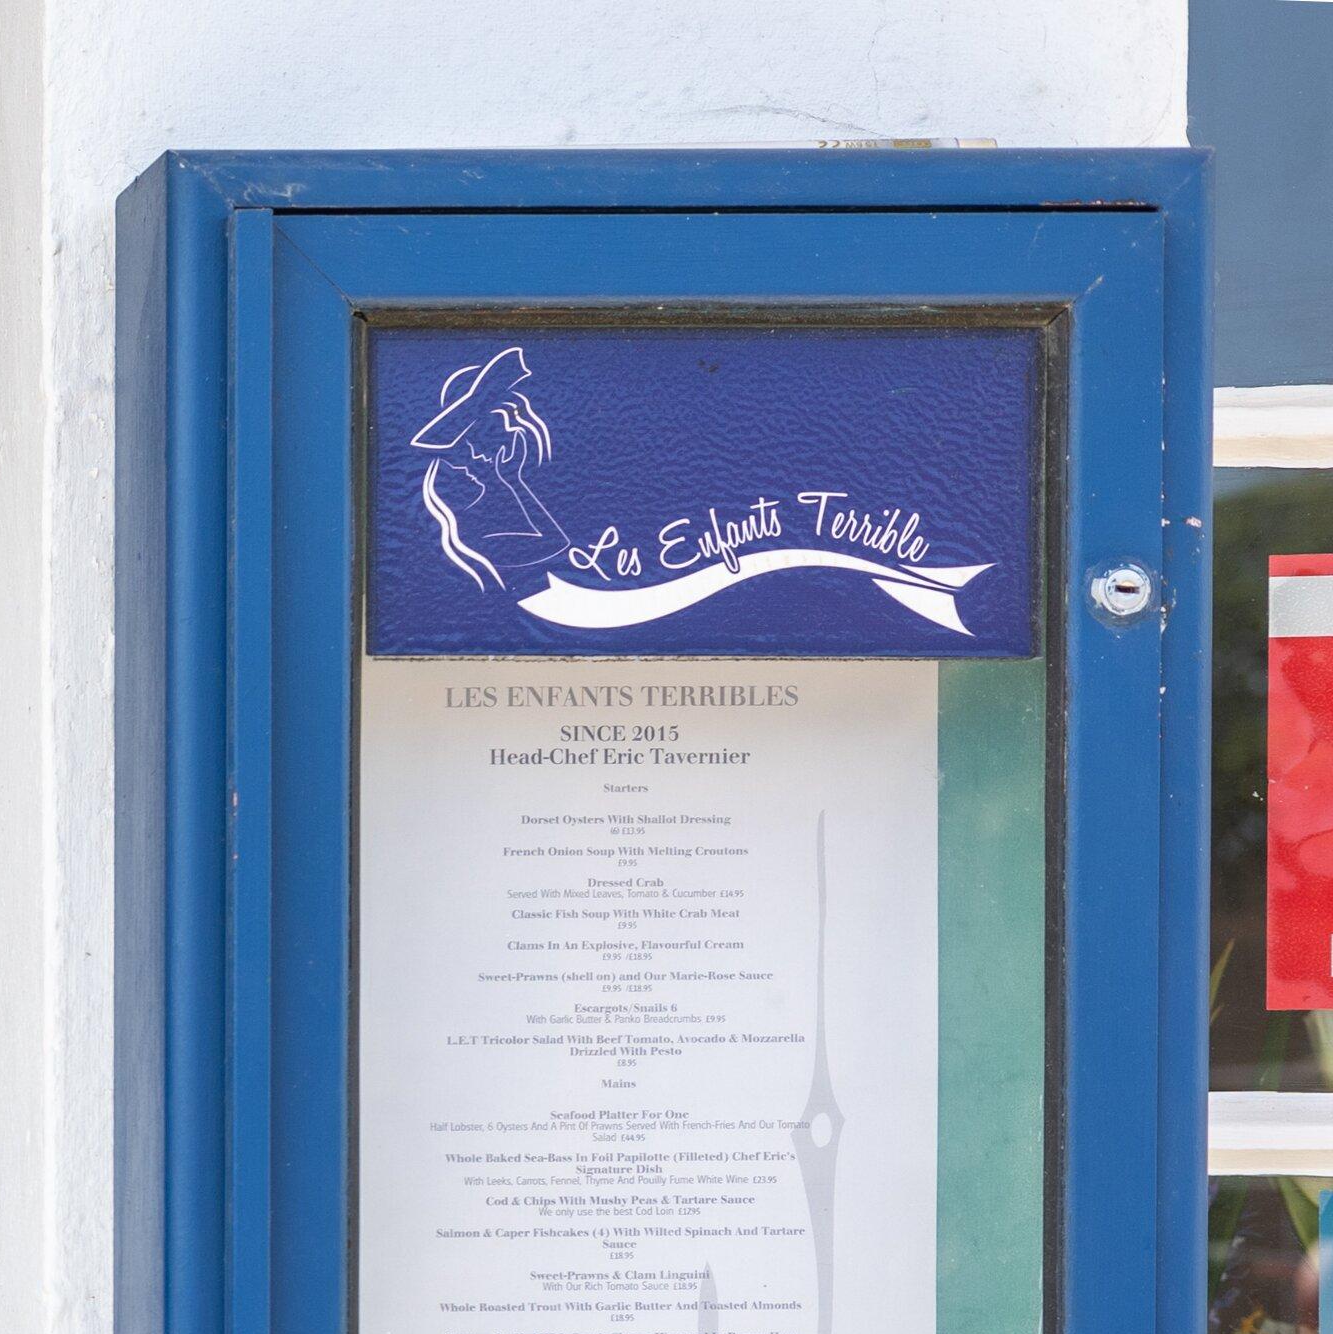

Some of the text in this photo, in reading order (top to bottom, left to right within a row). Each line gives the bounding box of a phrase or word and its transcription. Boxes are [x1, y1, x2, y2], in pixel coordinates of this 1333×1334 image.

[569, 491, 931, 581] Les Enfants Terrible
[446, 685, 799, 708] LES ENFANTS TERRIBLES
[560, 725, 679, 742] SINCE 2015
[603, 748, 645, 765] Eric
[649, 747, 751, 764] Tavernier
[603, 784, 649, 793] Starters
[521, 814, 732, 825] Dorset Oysters With Shallot Dressing
[503, 846, 749, 858] French Onion Soup With Melting Croutons
[587, 877, 665, 888] Dressed Crab
[511, 908, 741, 921] Classic Fish Soup With White Crab Meat
[507, 941, 545, 950] Clams
[641, 940, 702, 950] Flavourful
[704, 940, 745, 949] Cream
[618, 972, 641, 981] and
[643, 971, 667, 981] Our
[738, 972, 774, 980] Sauce
[569, 1046, 683, 1056] Drizzled With Pesto
[601, 1079, 637, 1089] Mains
[550, 1110, 690, 1120] Seafood Platter For One
[485, 1196, 509, 1206] Cod
[523, 1196, 557, 1207] Chips
[559, 1196, 587, 1206] With
[589, 1196, 627, 1205] Mushy
[631, 1195, 658, 1205] Peas
[673, 1195, 718, 1204] Tartare
[720, 1196, 756, 1204] Sauce
[624, 1270, 657, 1280] Clam
[659, 1270, 711, 1280] Linguini
